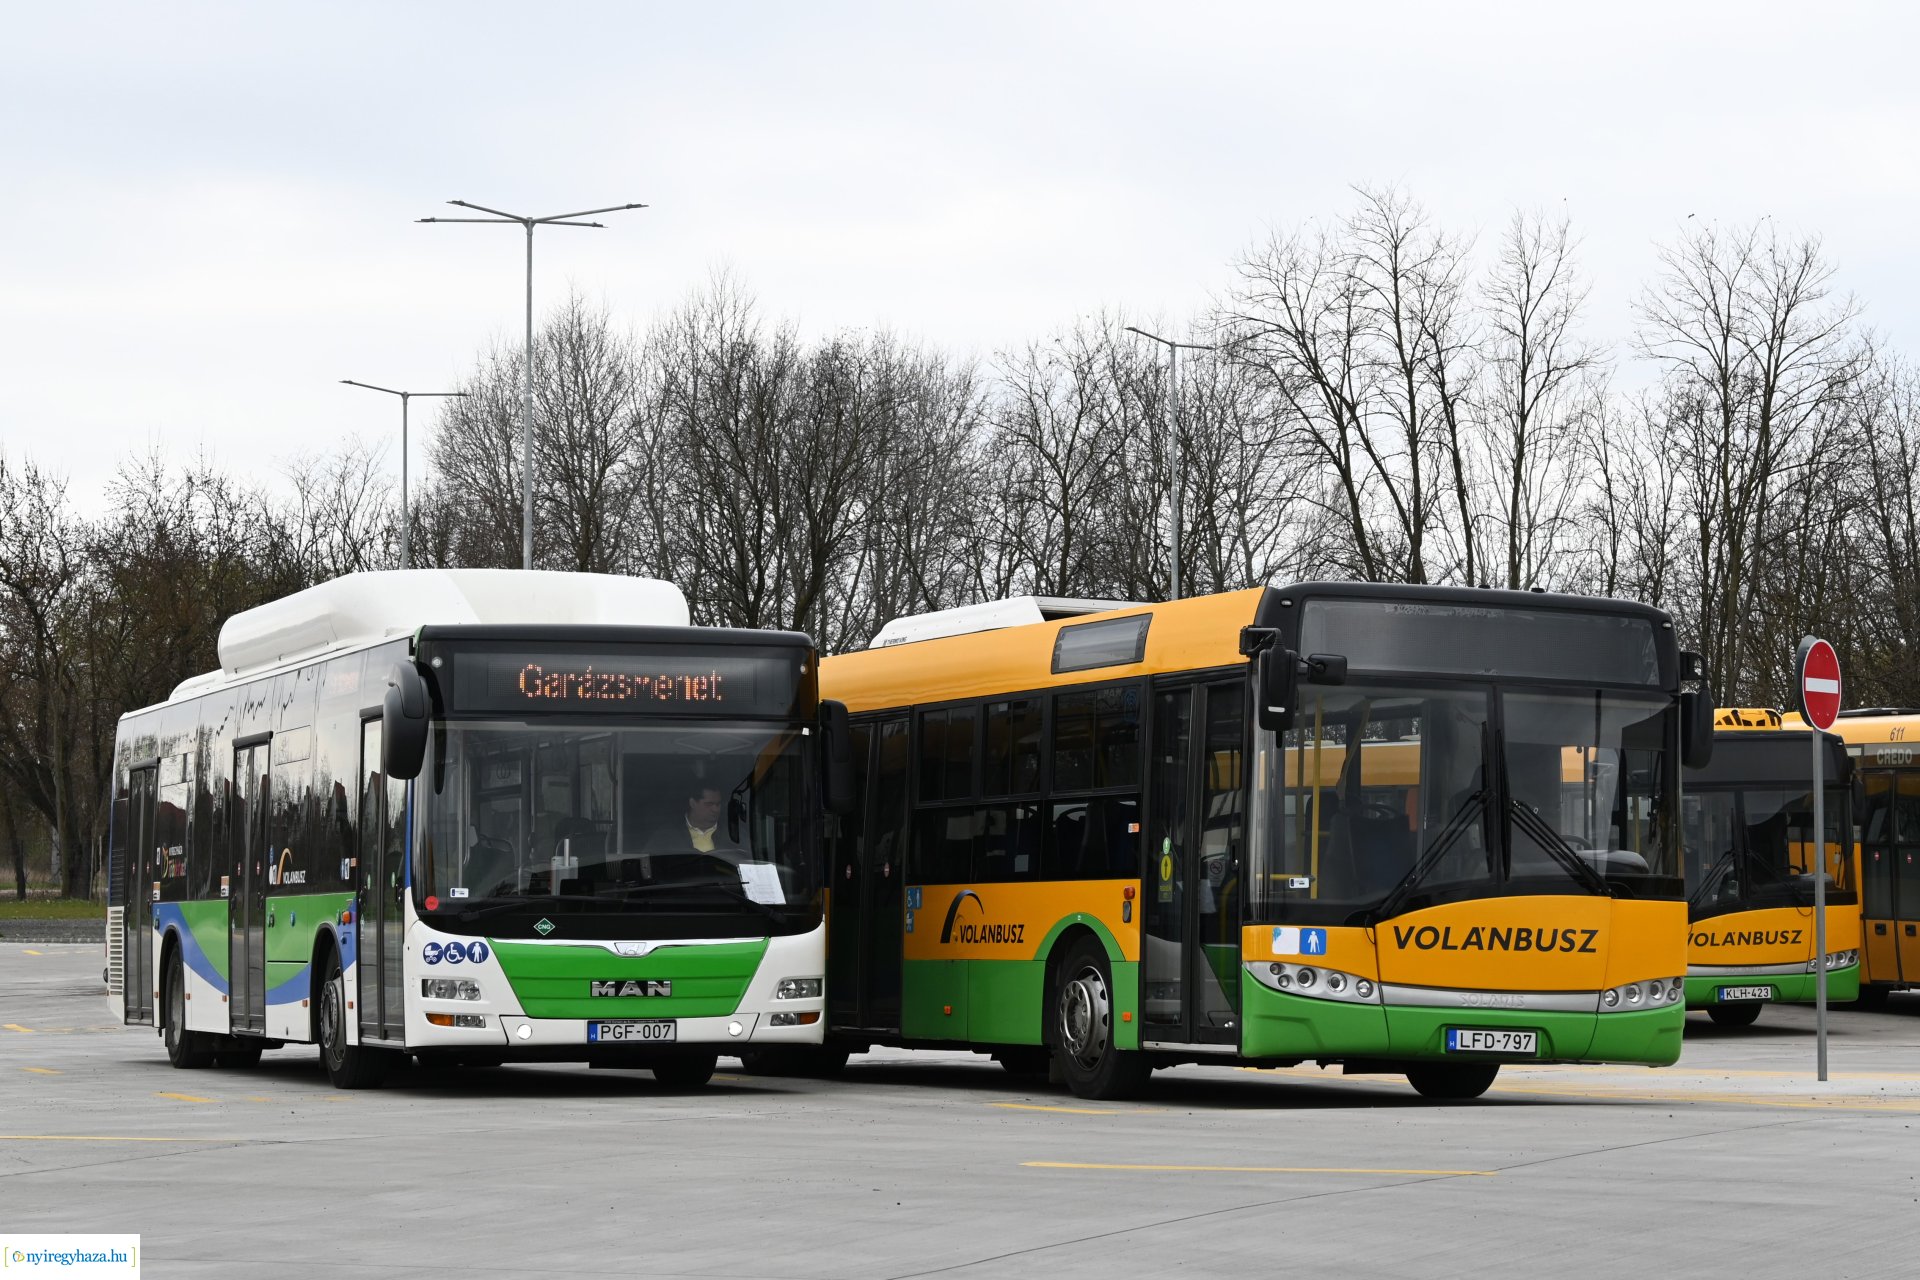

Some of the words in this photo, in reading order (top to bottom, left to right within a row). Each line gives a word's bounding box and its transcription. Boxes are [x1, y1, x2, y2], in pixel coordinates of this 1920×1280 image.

[1889, 726, 1905, 741] 611
[1876, 748, 1912, 765] CREDO
[959, 924, 1025, 944] VOLÁNBUSZ
[1393, 926, 1599, 953] VOLÁNBUSZ
[591, 980, 671, 997] MAN
[1726, 988, 1769, 999] KLH-423
[1459, 993, 1526, 1008] SOLARIS
[600, 1024, 672, 1040] PGF-007
[1459, 1032, 1532, 1051] LFD-797
